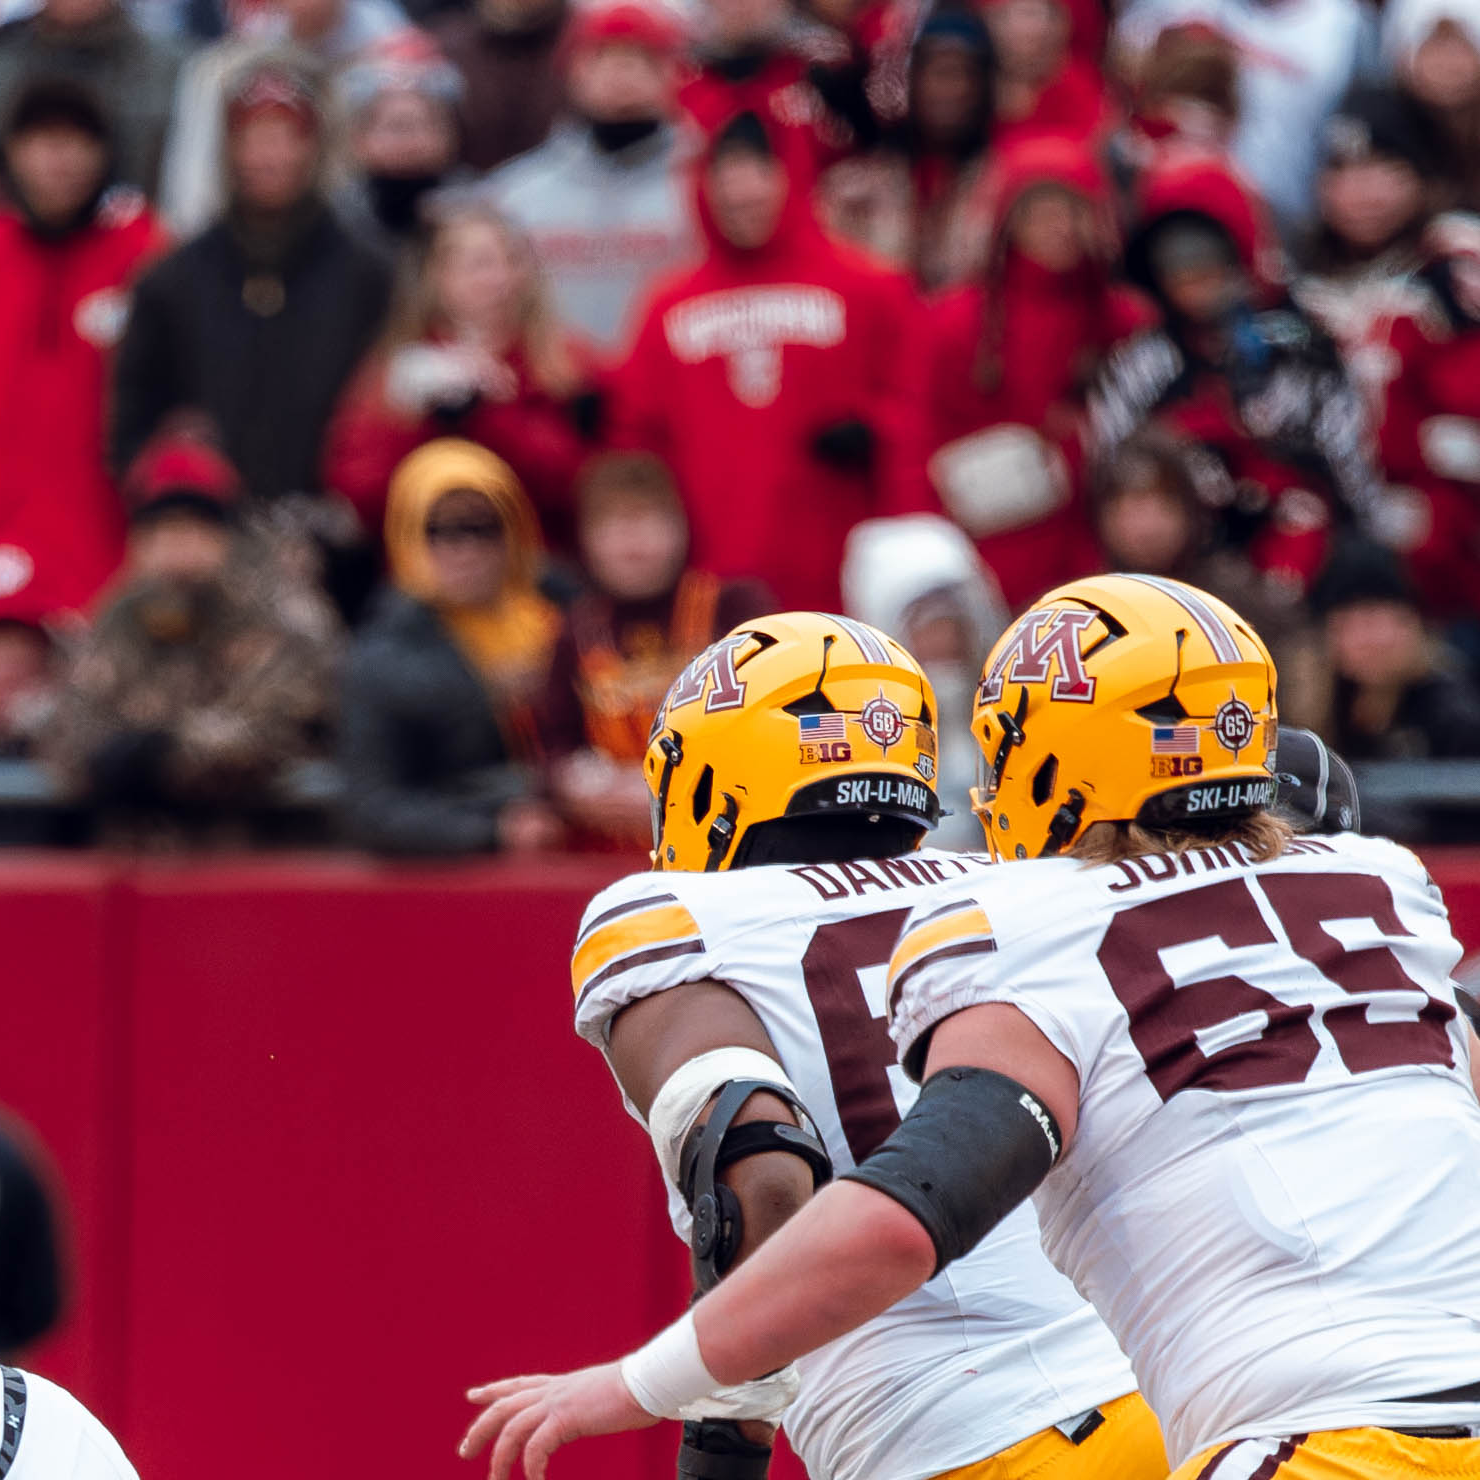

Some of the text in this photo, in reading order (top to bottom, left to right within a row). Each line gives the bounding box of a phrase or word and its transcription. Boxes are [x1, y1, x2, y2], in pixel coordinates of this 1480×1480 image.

[978, 609, 1101, 705] M
[872, 711, 895, 736] 60
[1224, 714, 1246, 737] 65
[836, 780, 928, 812] SKI-U-MAH
[1096, 872, 1458, 1102] 65
